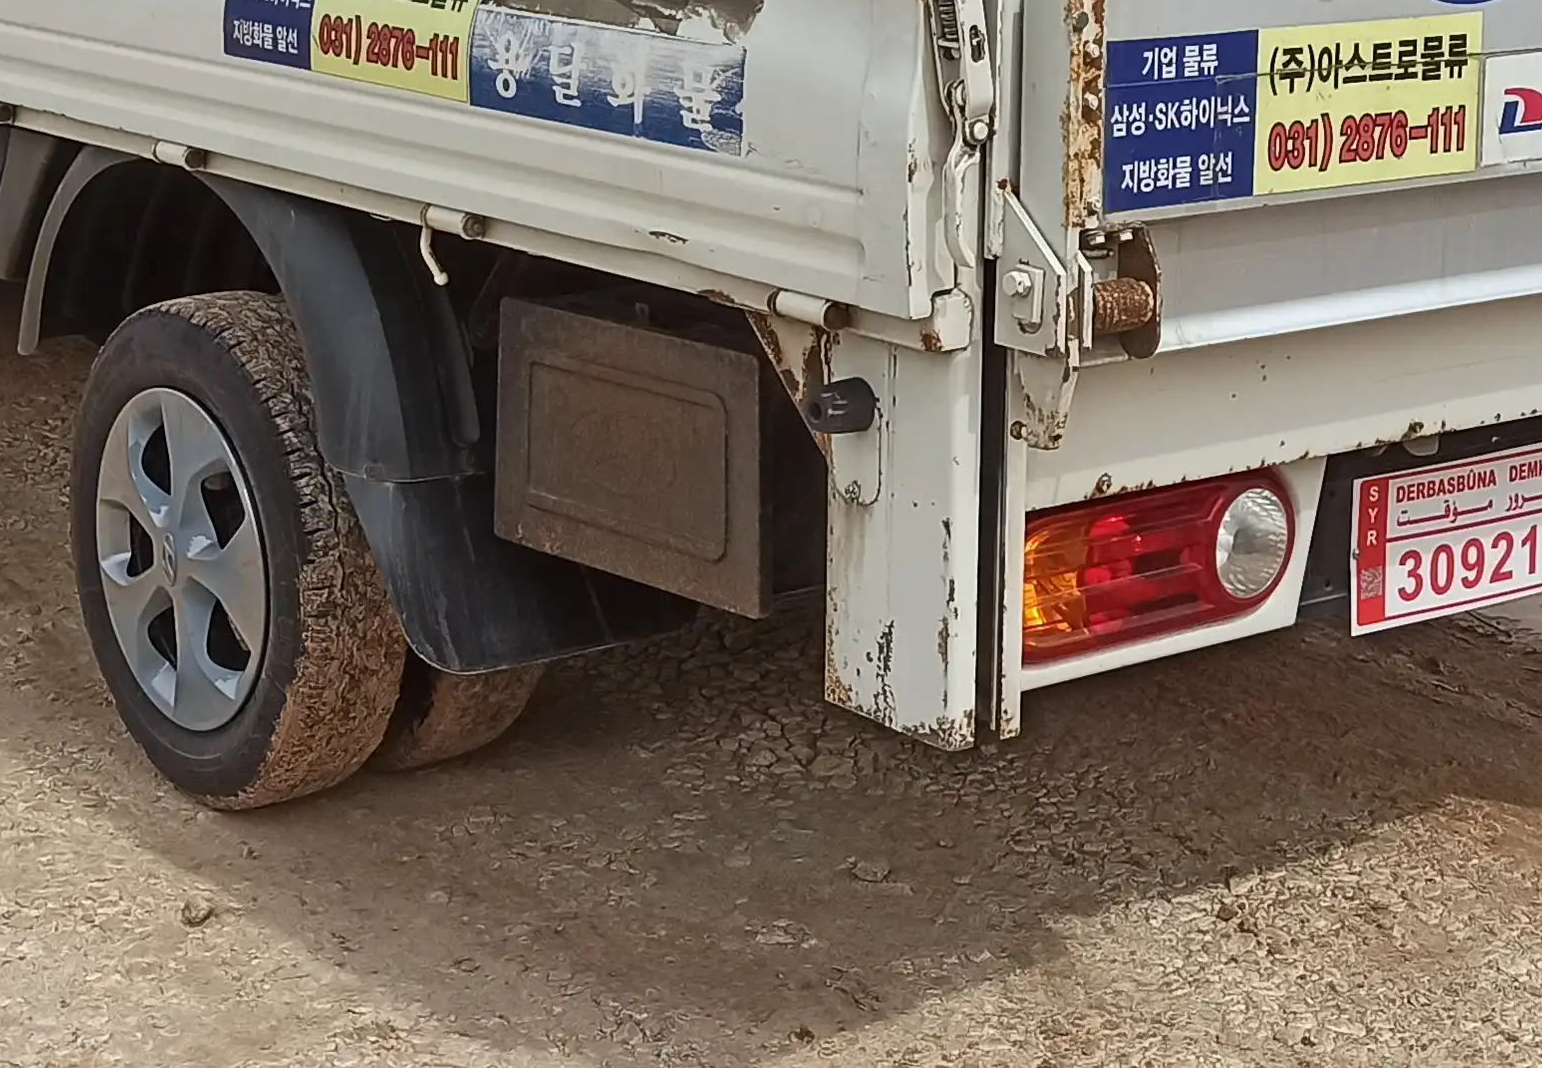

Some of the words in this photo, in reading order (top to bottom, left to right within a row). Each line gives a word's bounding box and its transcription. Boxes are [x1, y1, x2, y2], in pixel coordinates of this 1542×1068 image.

[233, 19, 274, 50] 지방화물
[276, 25, 299, 54] 알선
[319, 13, 362, 65] 031)
[366, 21, 460, 81] 2876-111
[1142, 47, 1178, 80] 기업
[1183, 43, 1219, 77] 물류
[1270, 33, 1469, 96] (주)아스트로물류
[1267, 112, 1334, 172] 031)
[1338, 104, 1467, 163] 2876-111
[1121, 158, 1192, 194] 지방화물
[1198, 151, 1233, 187] 알선
[1395, 469, 1497, 504] DERBASBÛNA
[1396, 498, 1494, 528] مؤقت
[1397, 524, 1538, 603] 30921
